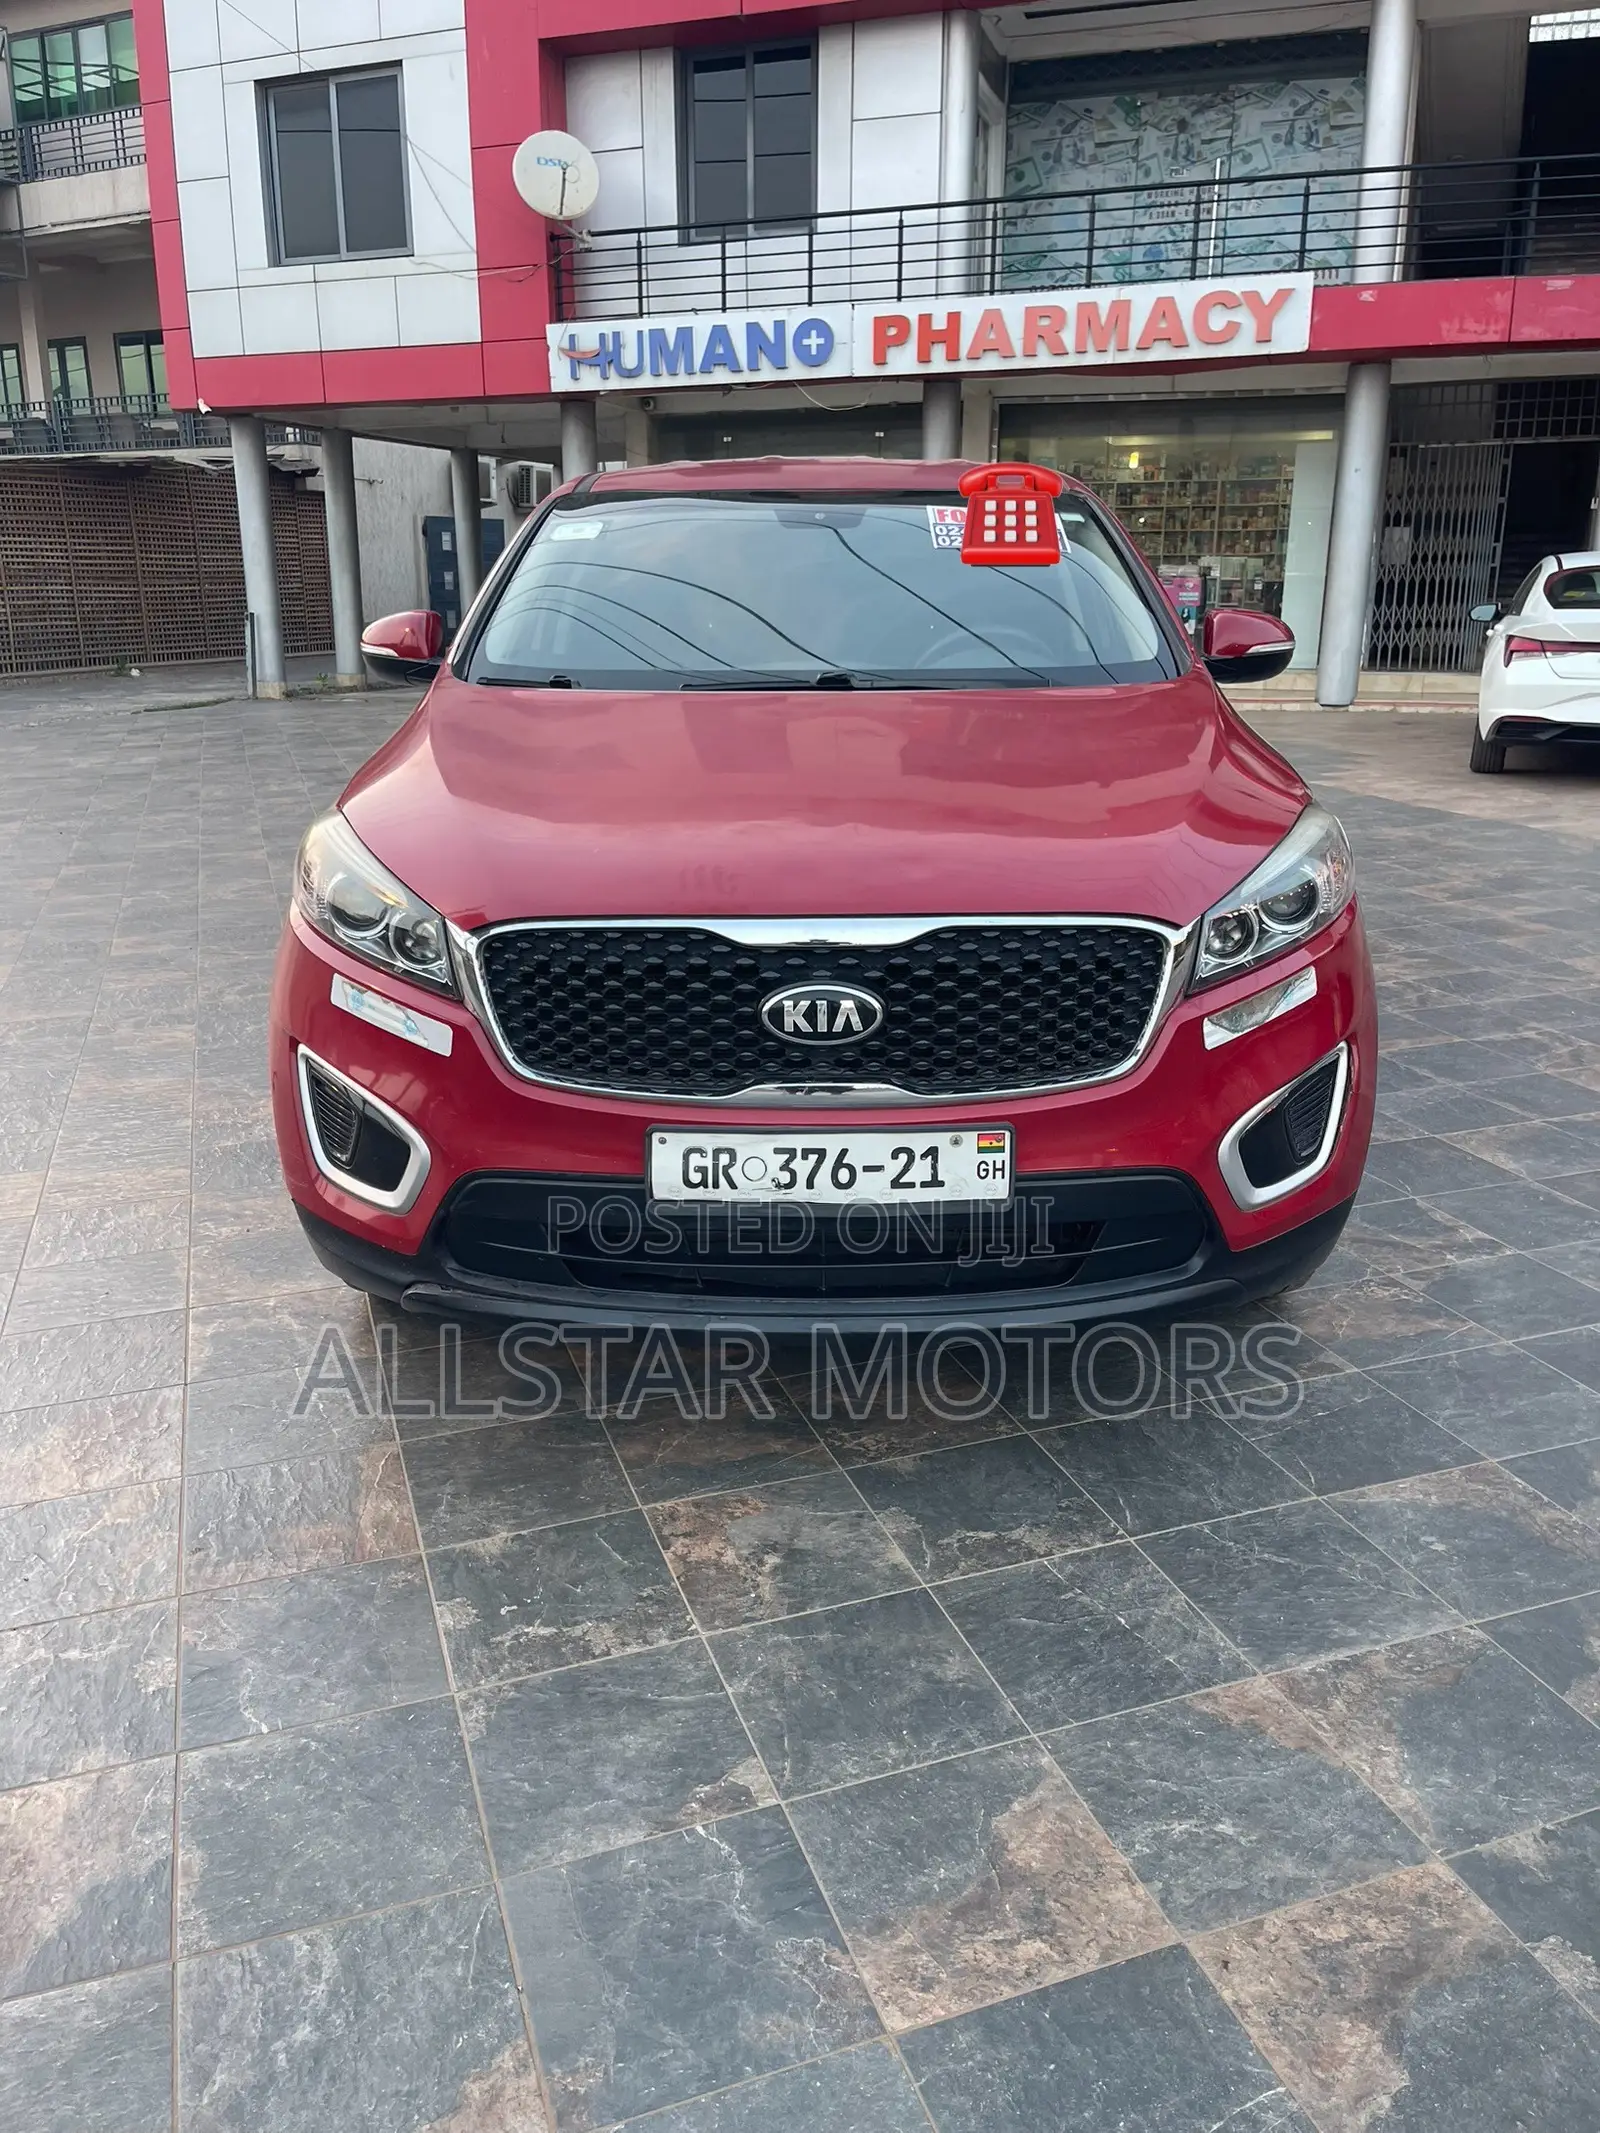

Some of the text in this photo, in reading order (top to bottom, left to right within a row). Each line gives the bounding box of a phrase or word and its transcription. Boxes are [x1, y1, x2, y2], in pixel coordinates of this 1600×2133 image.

[568, 287, 1296, 381] HUMANO PHARMACY
[936, 508, 967, 523] FO
[782, 1000, 864, 1033] KIA
[682, 1145, 946, 1190] GR 376-21
[976, 1160, 1005, 1181] GH
